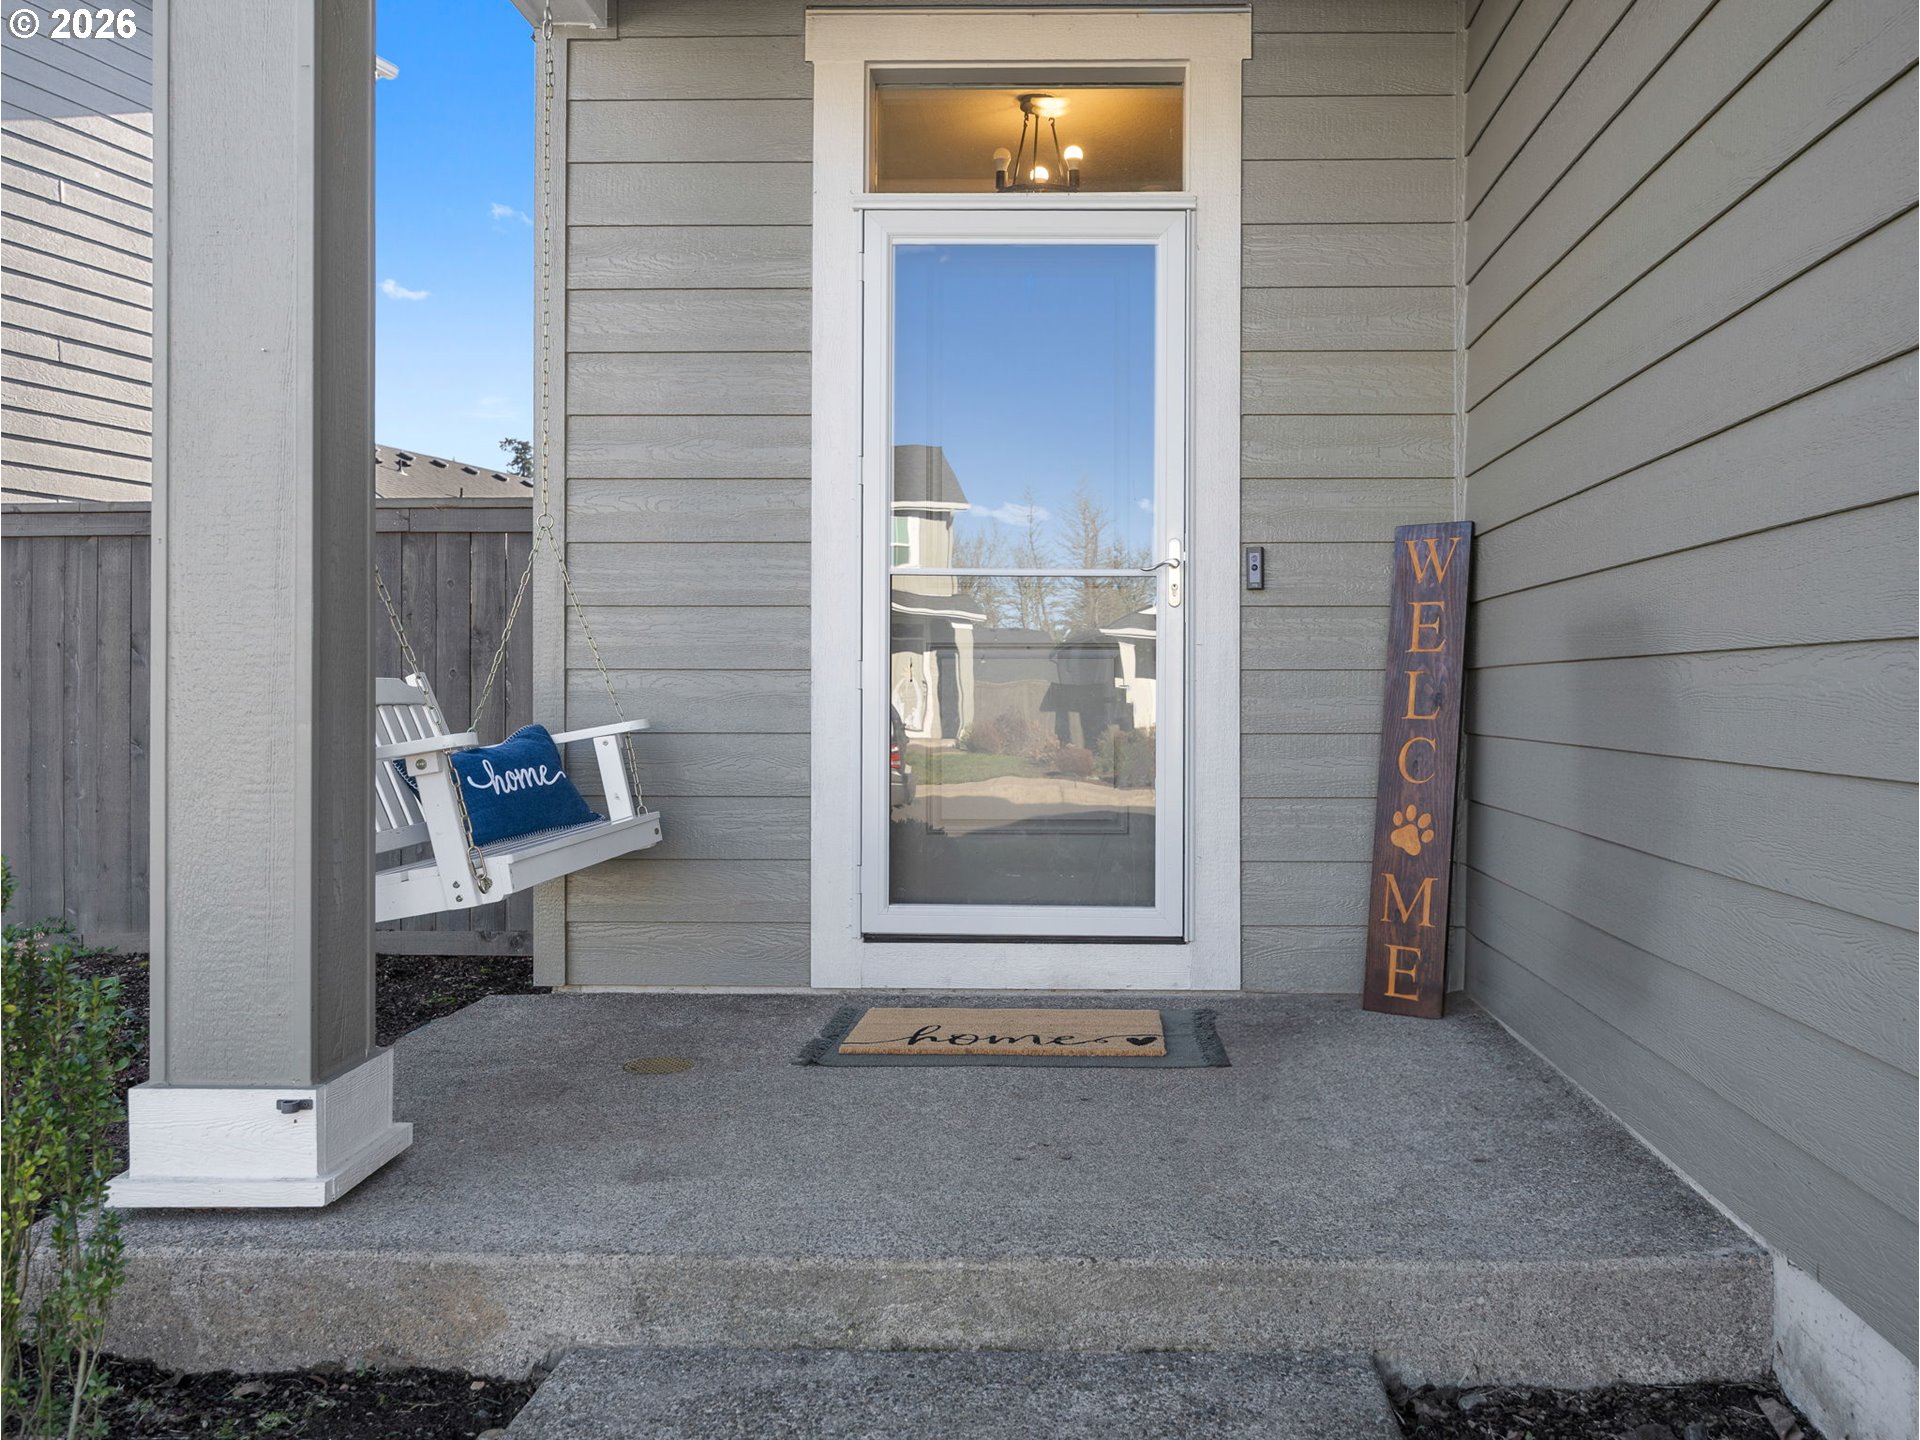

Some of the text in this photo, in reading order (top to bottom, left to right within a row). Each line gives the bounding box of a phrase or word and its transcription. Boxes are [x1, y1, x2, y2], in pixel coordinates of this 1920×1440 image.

[466, 759, 567, 795] home
[1380, 536, 1462, 1002] WELCME
[843, 1024, 1109, 1047] home
